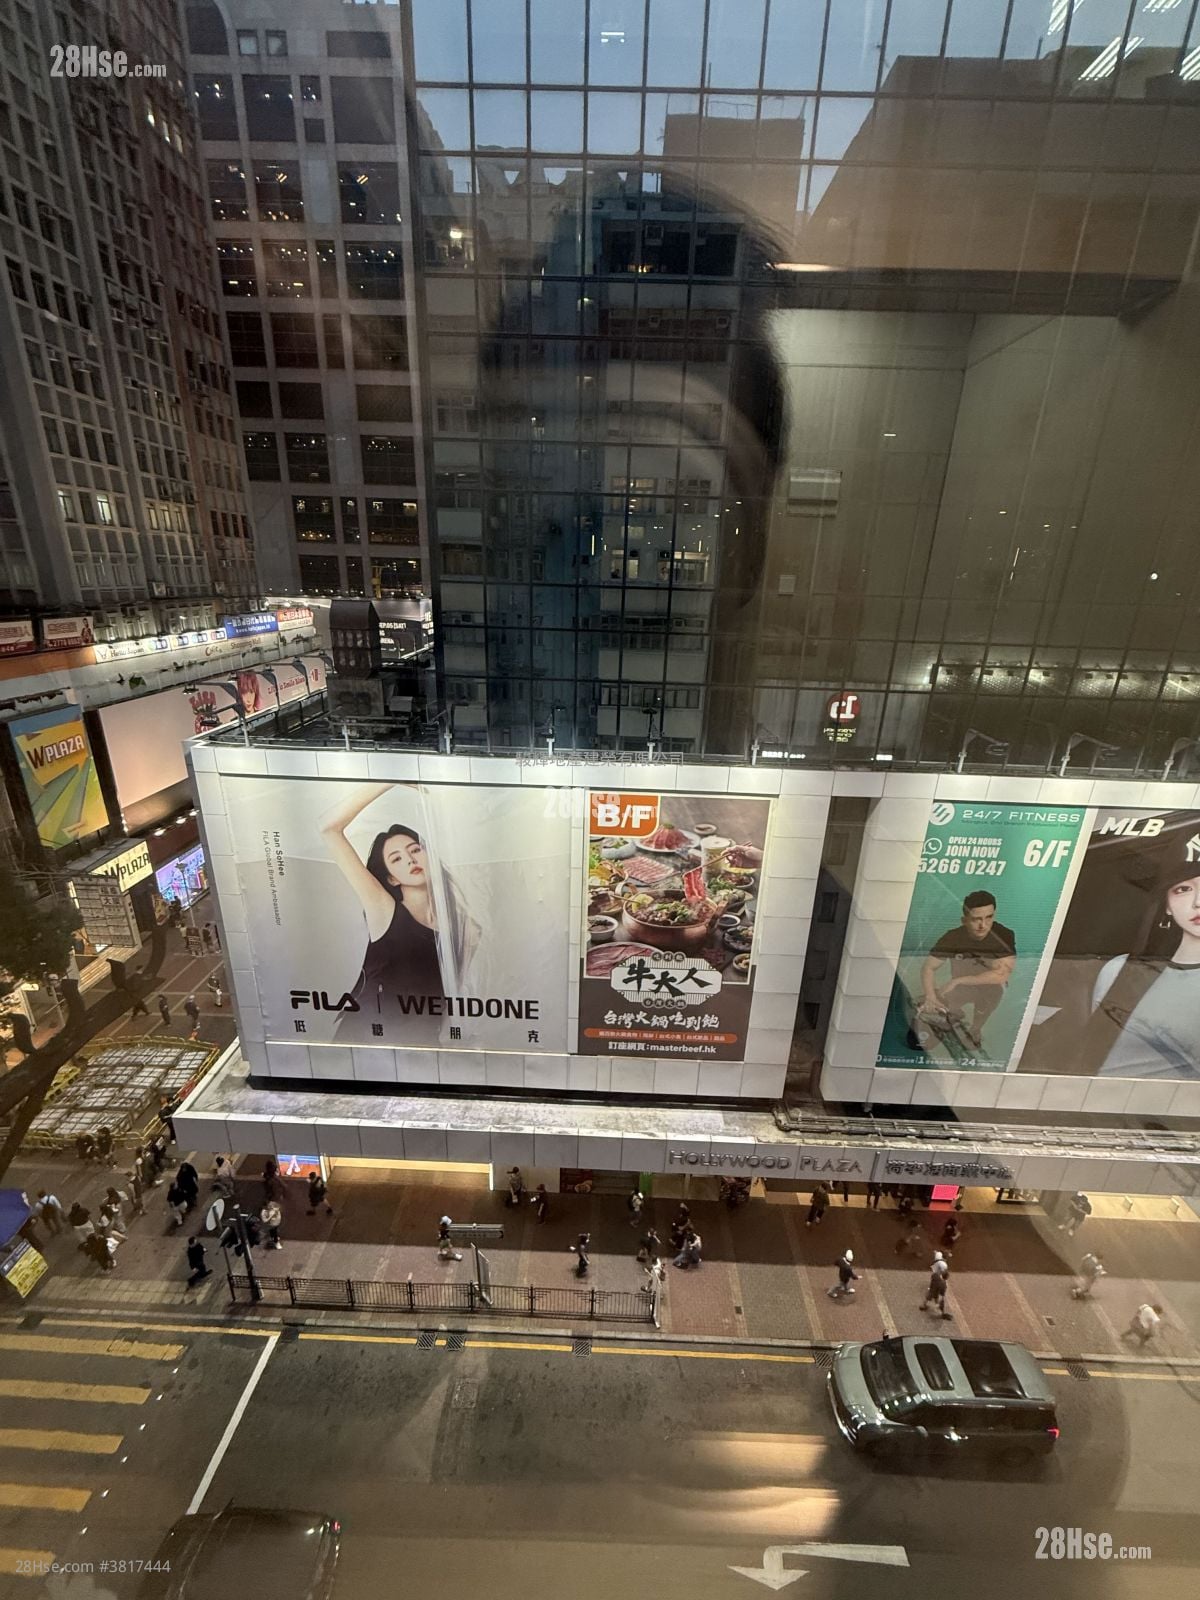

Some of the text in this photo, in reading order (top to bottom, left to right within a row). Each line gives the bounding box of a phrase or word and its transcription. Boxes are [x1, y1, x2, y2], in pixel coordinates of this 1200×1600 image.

[597, 804, 652, 828] B/F
[962, 809, 1081, 823] 24/7 FITNESS
[1099, 816, 1165, 837] MLB
[948, 836, 966, 844] OPEN
[967, 837, 976, 845] 24
[945, 845, 1000, 858] JOIN NOW
[1023, 839, 1072, 868] 6/F
[964, 859, 1007, 876] 0247
[290, 990, 360, 1012] FILA
[603, 1010, 719, 1031] 台灣火鍋吃到飽
[669, 1150, 862, 1173] HOLLYWOOD PLAZA
